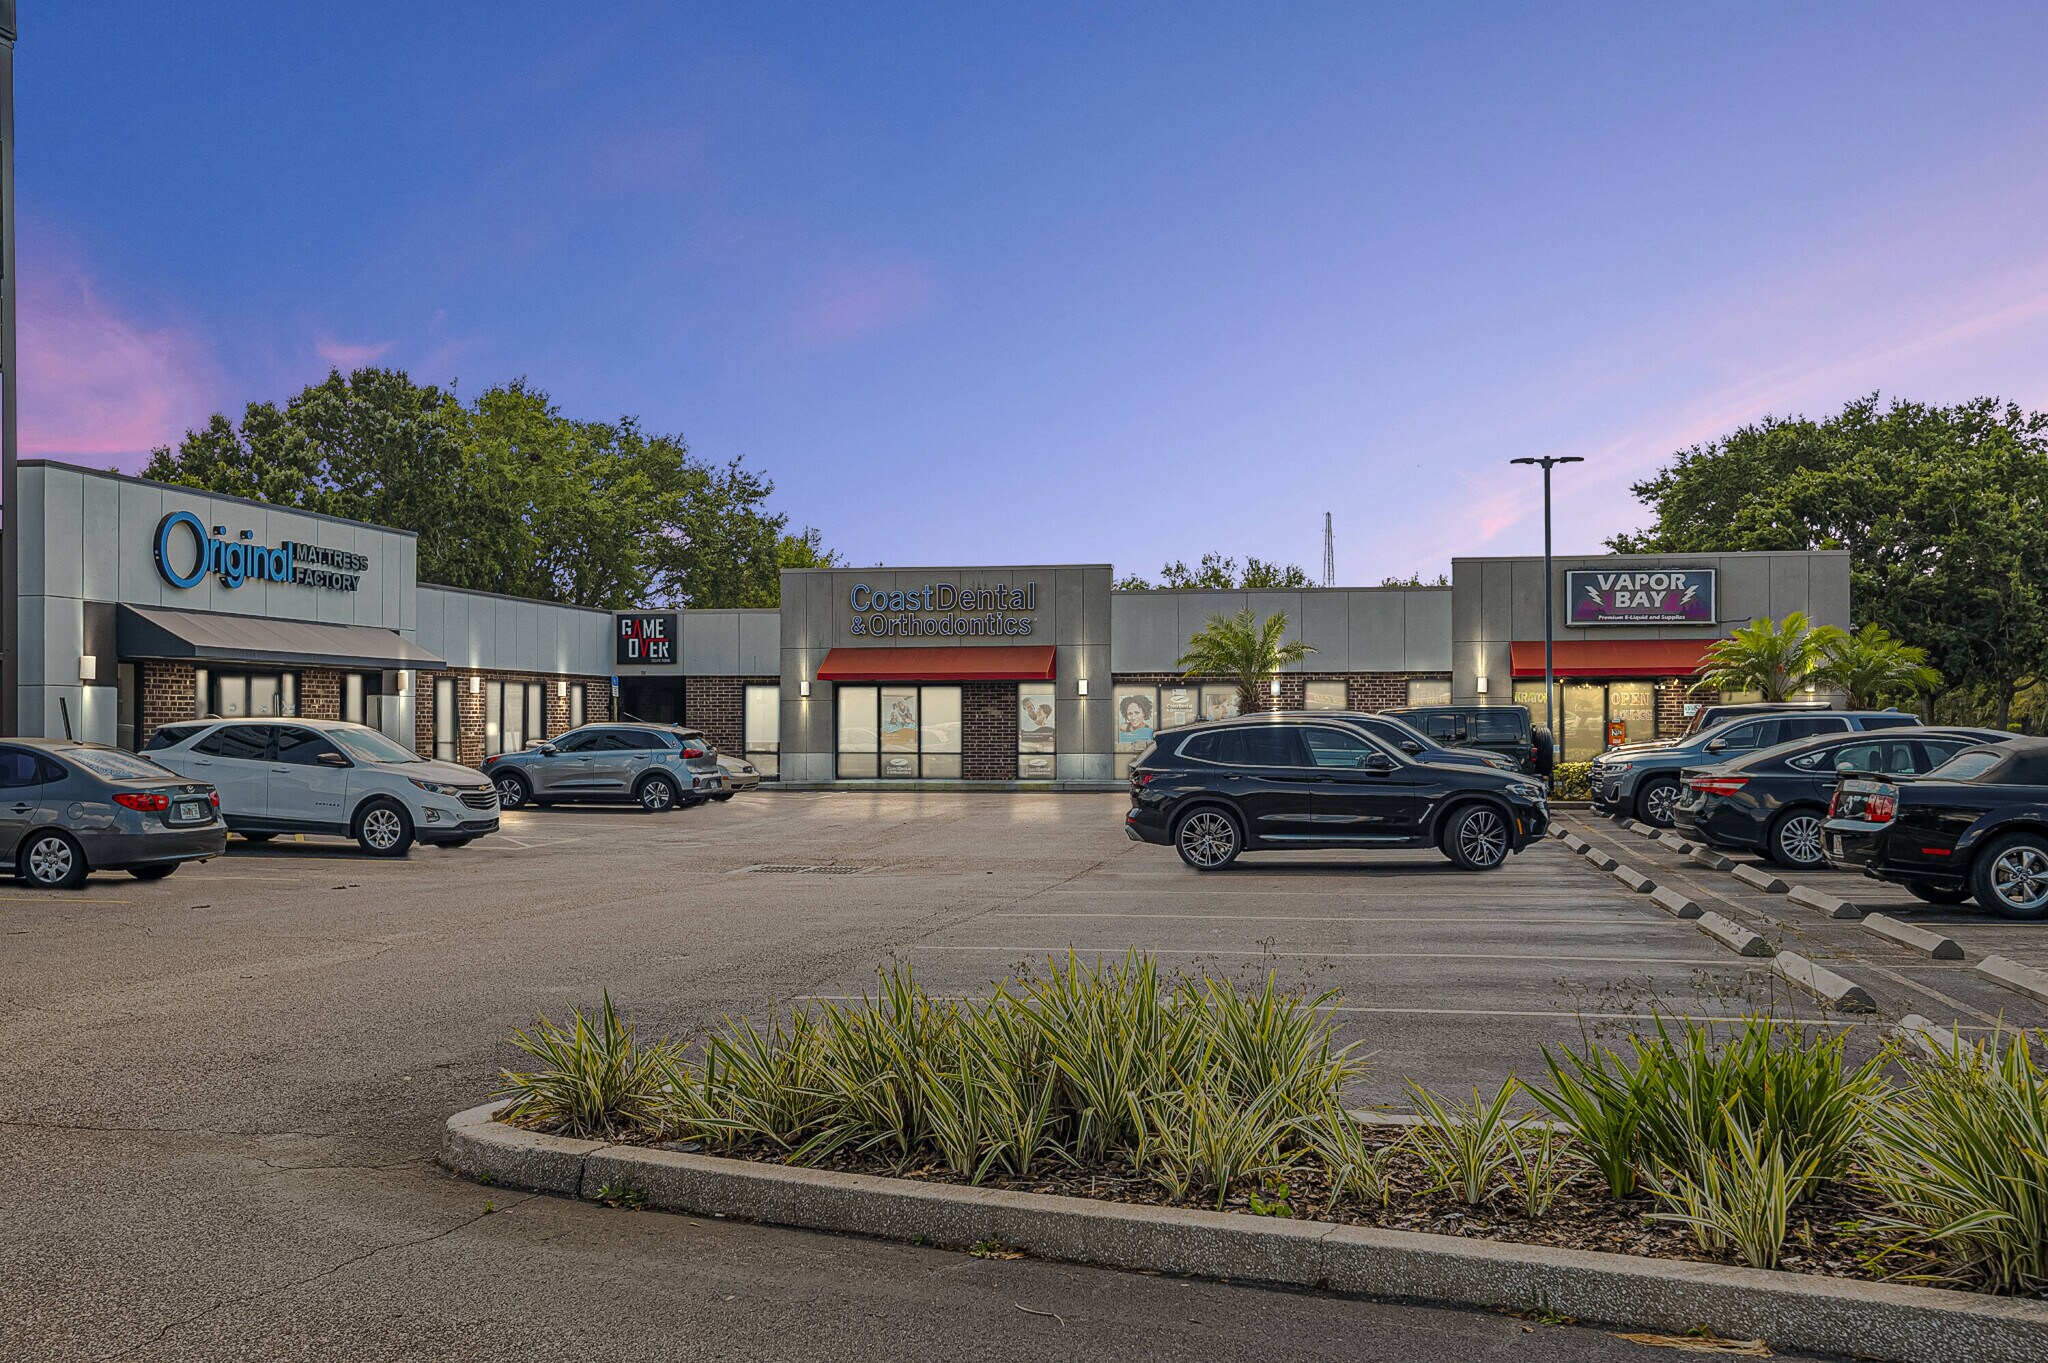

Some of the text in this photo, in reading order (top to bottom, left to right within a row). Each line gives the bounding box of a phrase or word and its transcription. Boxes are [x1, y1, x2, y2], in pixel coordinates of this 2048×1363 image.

[154, 510, 293, 589] Original
[296, 544, 369, 571] MATTRESS
[296, 566, 361, 591] FACTORY
[1597, 573, 1687, 591] VAPOR
[1615, 591, 1668, 608] BAY
[621, 619, 664, 639] GAME
[850, 612, 1032, 637] & Orthodontics
[629, 638, 669, 658] OVER
[1611, 692, 1650, 706] OPEN
[1613, 709, 1653, 720] LOUNGE
